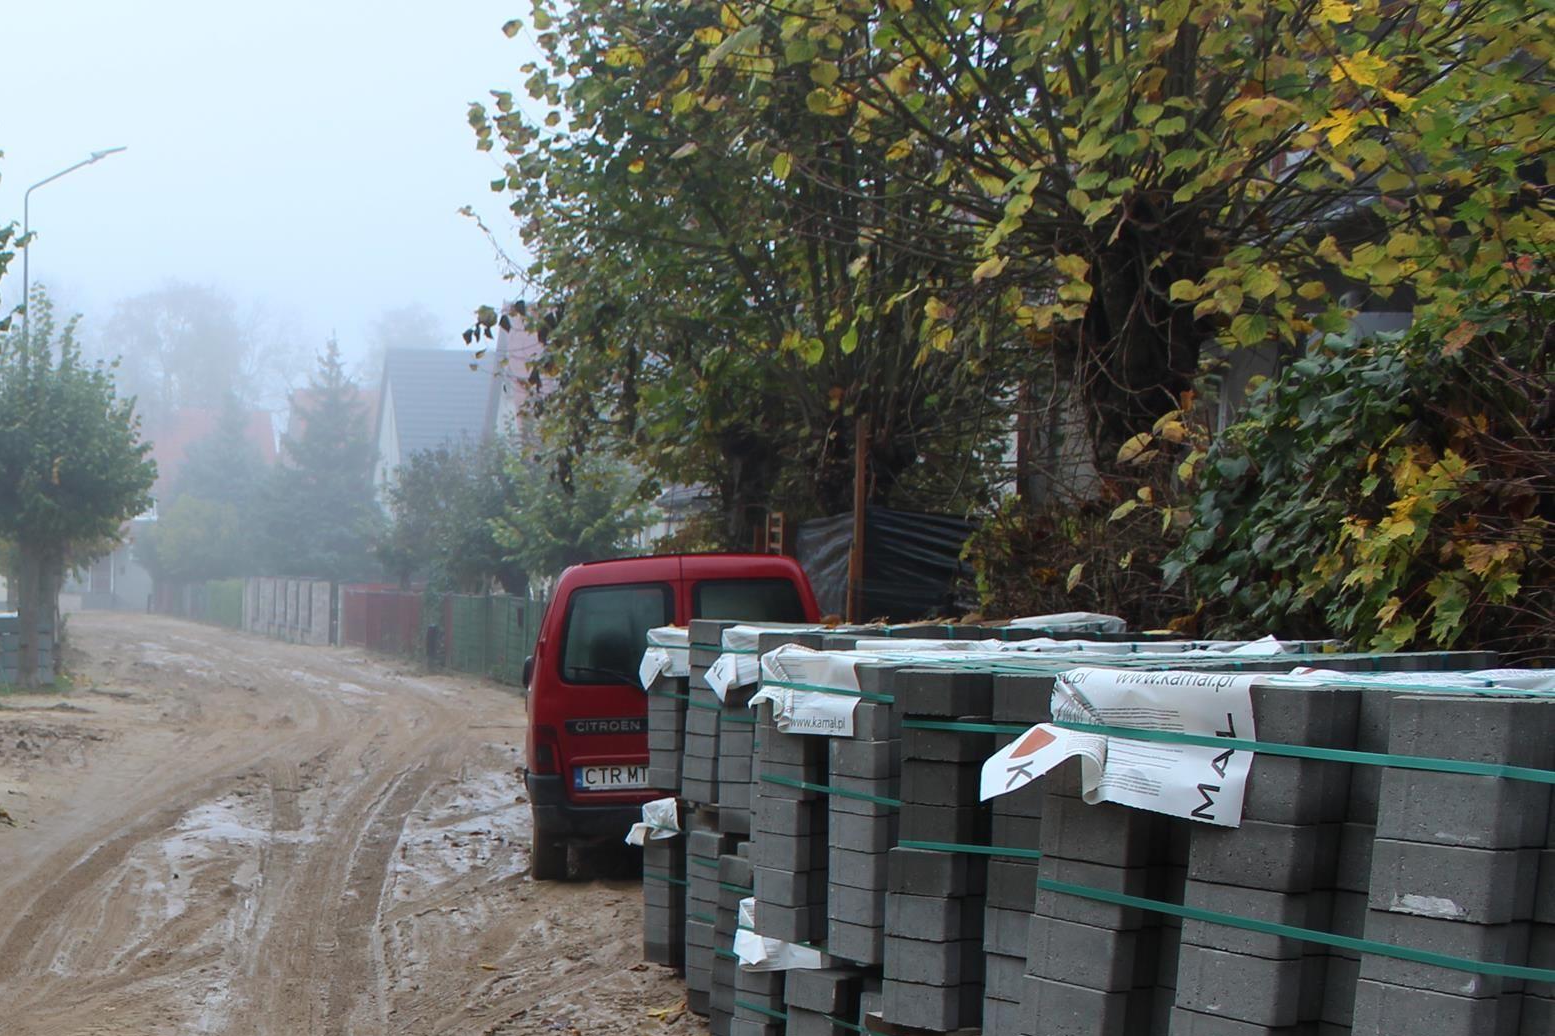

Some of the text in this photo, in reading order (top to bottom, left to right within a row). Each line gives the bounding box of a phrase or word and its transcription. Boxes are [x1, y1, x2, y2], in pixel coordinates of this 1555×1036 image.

[1116, 672, 1237, 693] www.kamal.pl
[790, 716, 846, 733] www.kamal.pl
[585, 767, 622, 784] CTR
